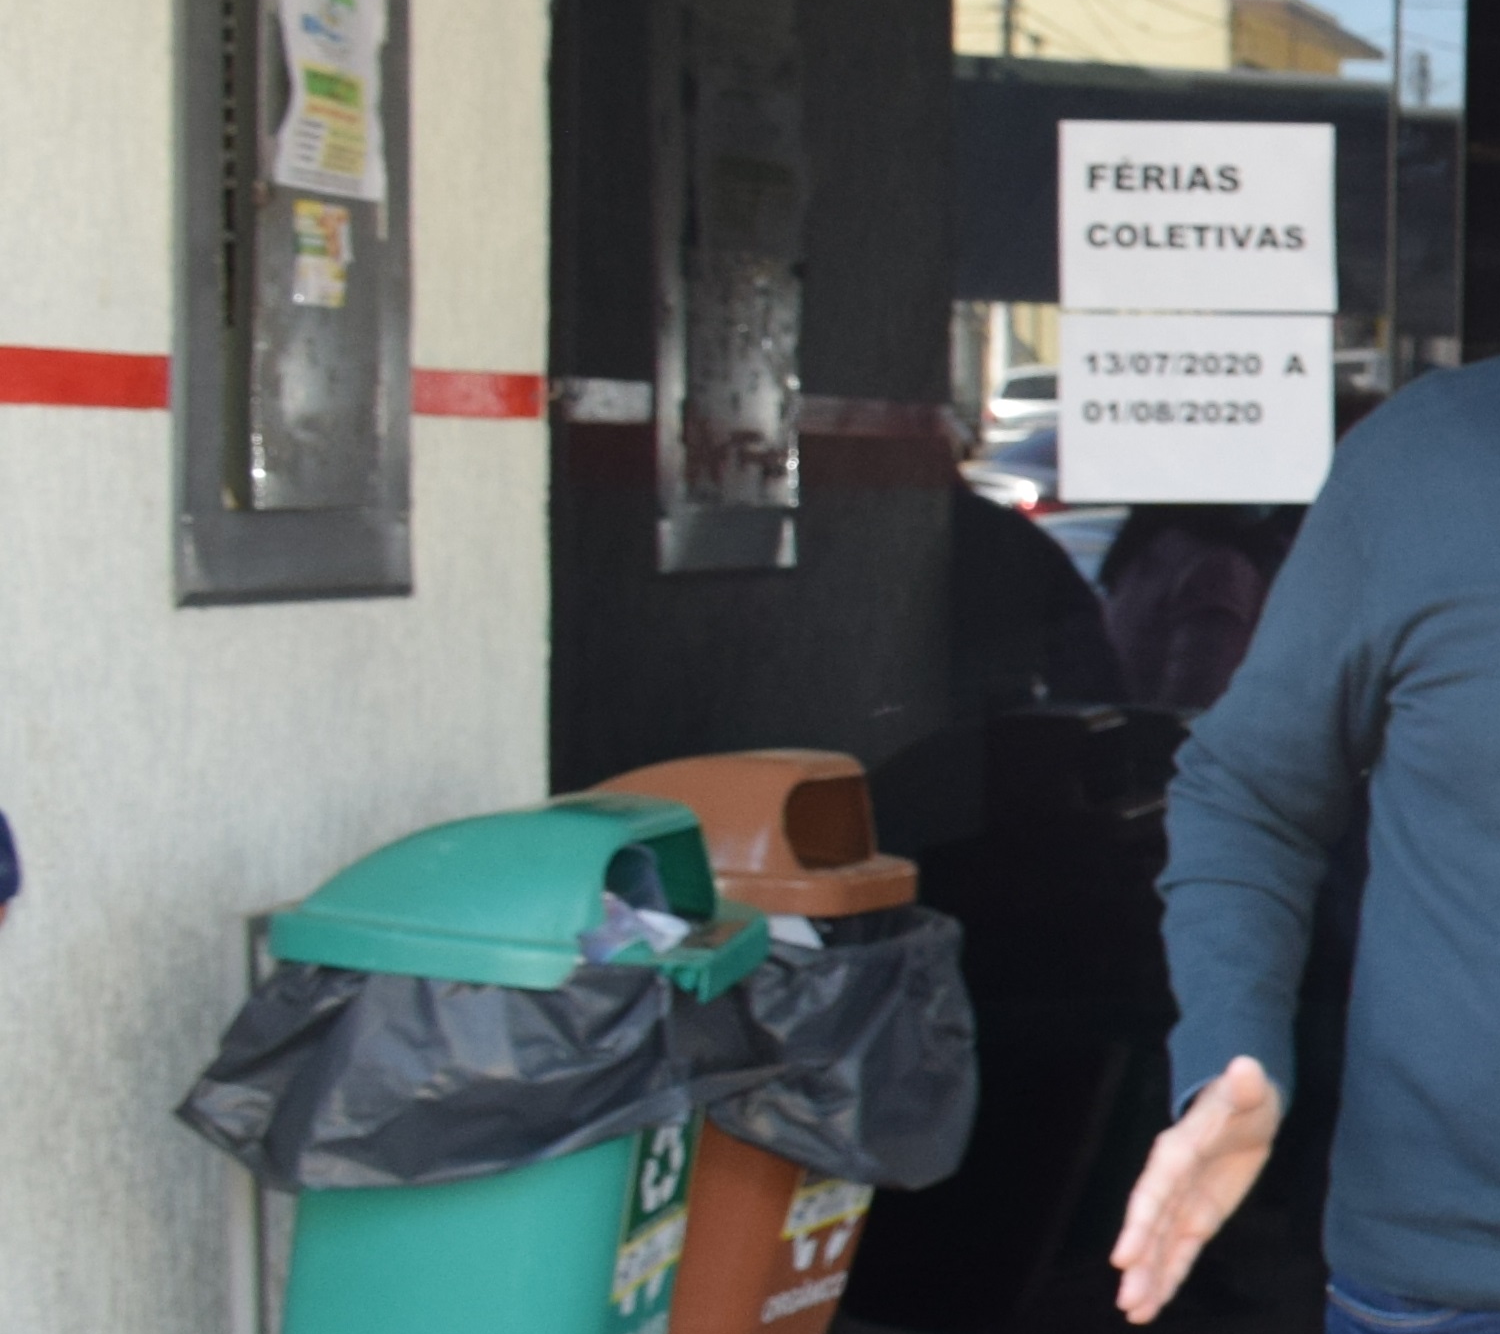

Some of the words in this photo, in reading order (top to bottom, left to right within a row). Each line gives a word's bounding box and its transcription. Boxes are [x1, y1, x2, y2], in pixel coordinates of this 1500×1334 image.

[1087, 157, 1241, 192] FÉRIAS
[1087, 224, 1306, 251] COLETIVAS
[1085, 353, 1262, 376] 13/07/2020
[1283, 354, 1306, 376] A
[1083, 401, 1263, 424] 01/08/2020
